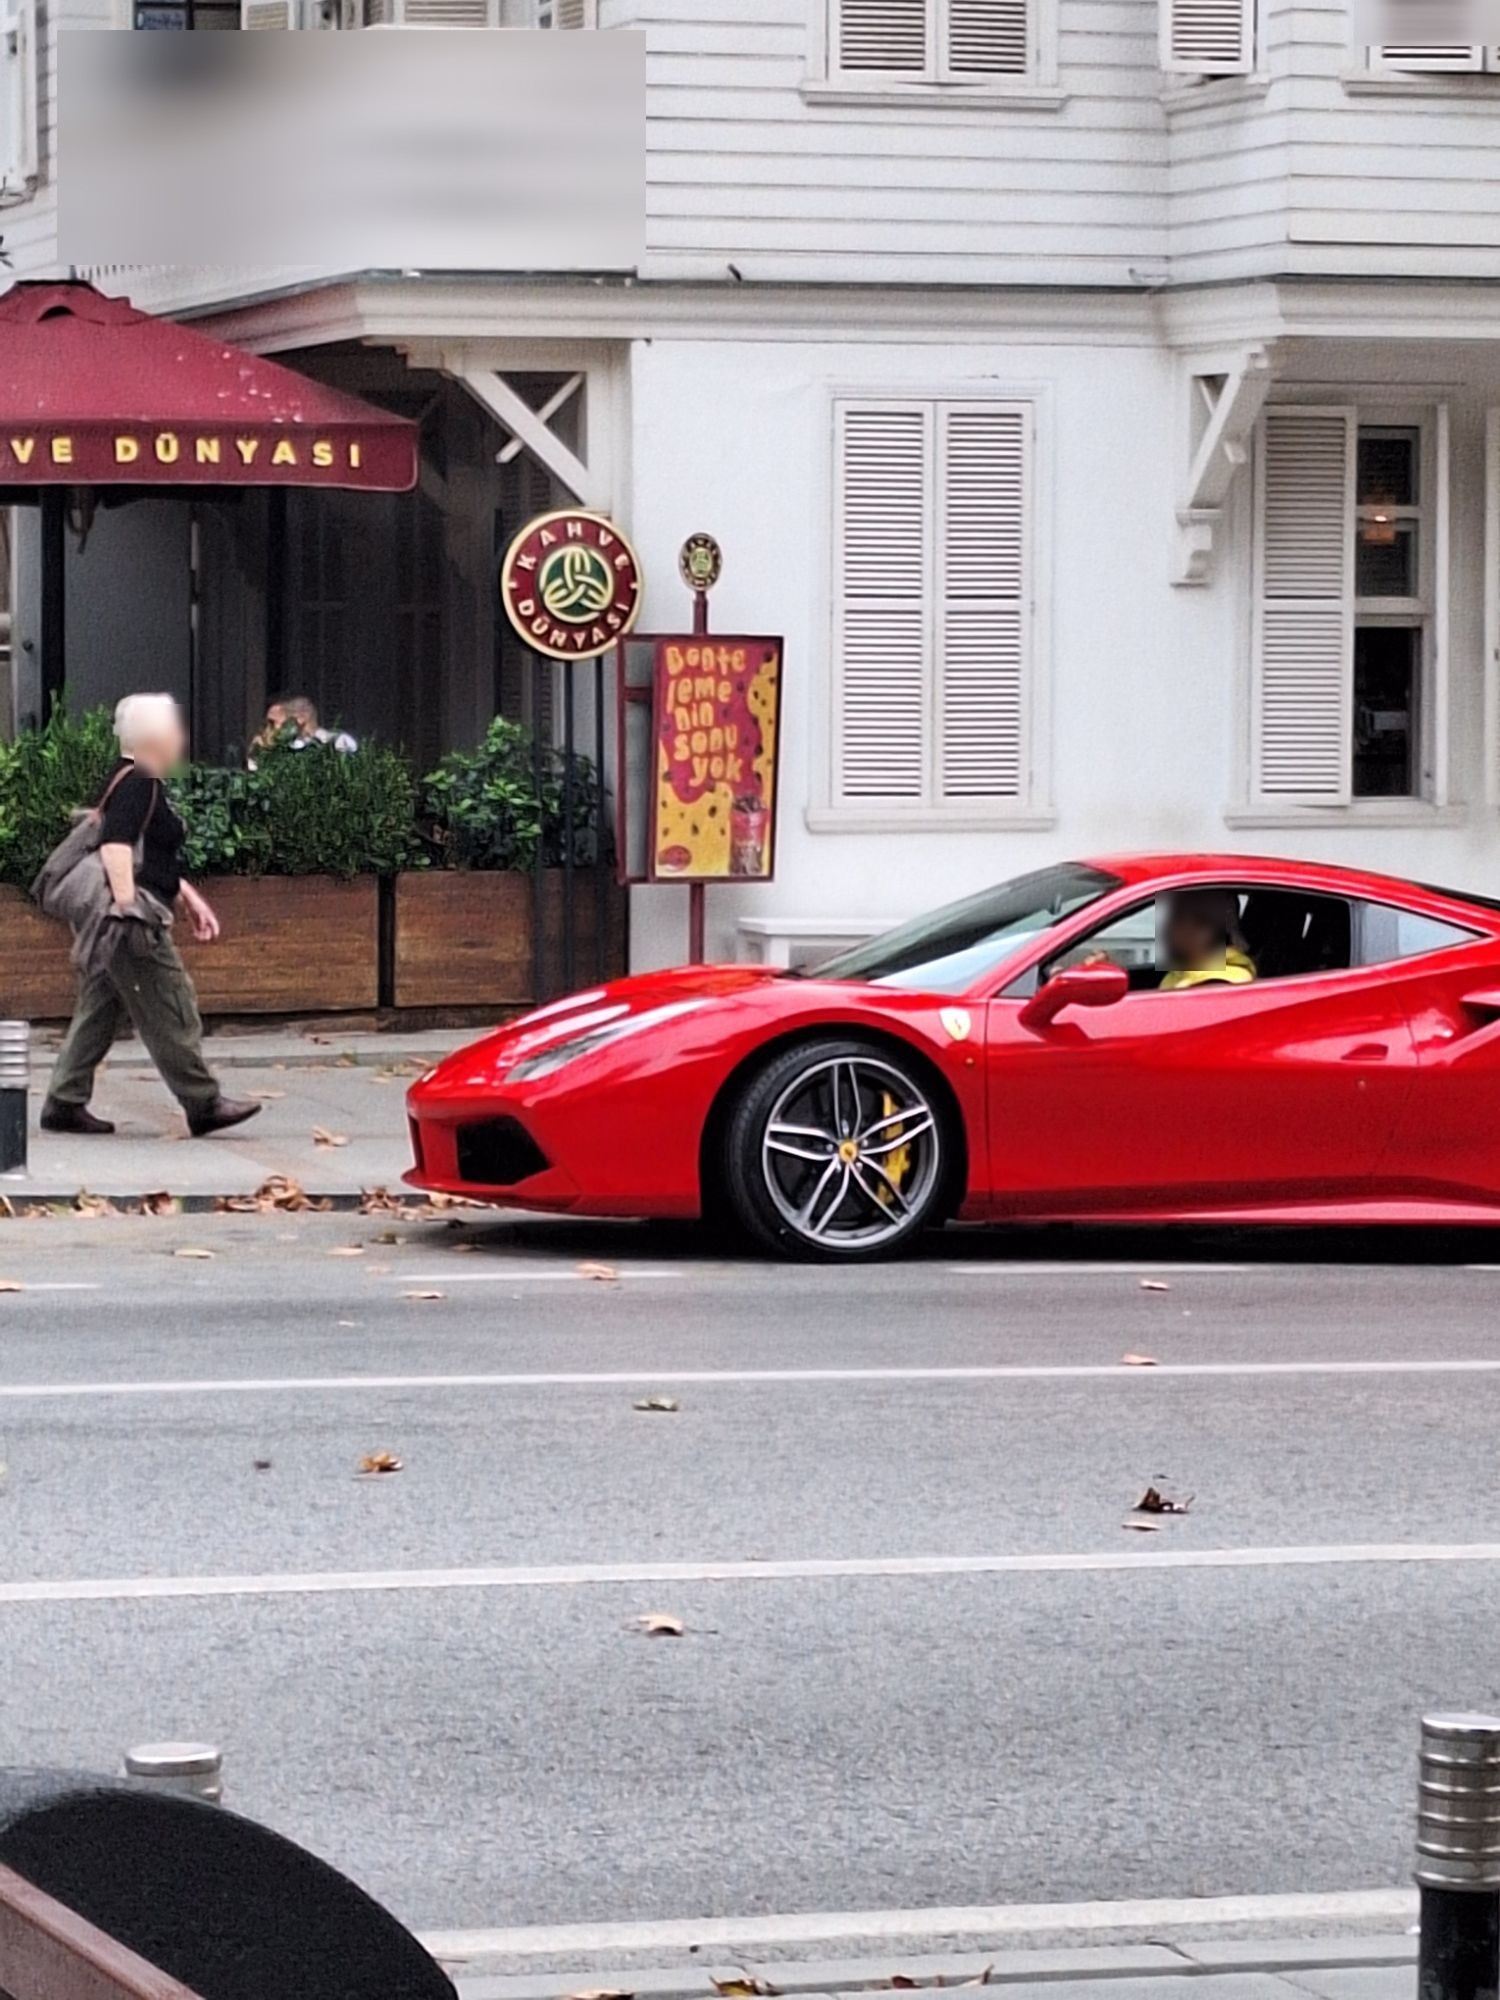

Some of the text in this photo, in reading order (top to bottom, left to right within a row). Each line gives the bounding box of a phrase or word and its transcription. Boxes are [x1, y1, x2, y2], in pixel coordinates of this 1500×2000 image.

[115, 432, 361, 468] DÜNYASI
[516, 521, 629, 572] KAHVE
[517, 599, 630, 649] DÜNYASI
[674, 702, 714, 731] nin
[673, 724, 738, 761] sonu
[689, 753, 743, 787] yok
